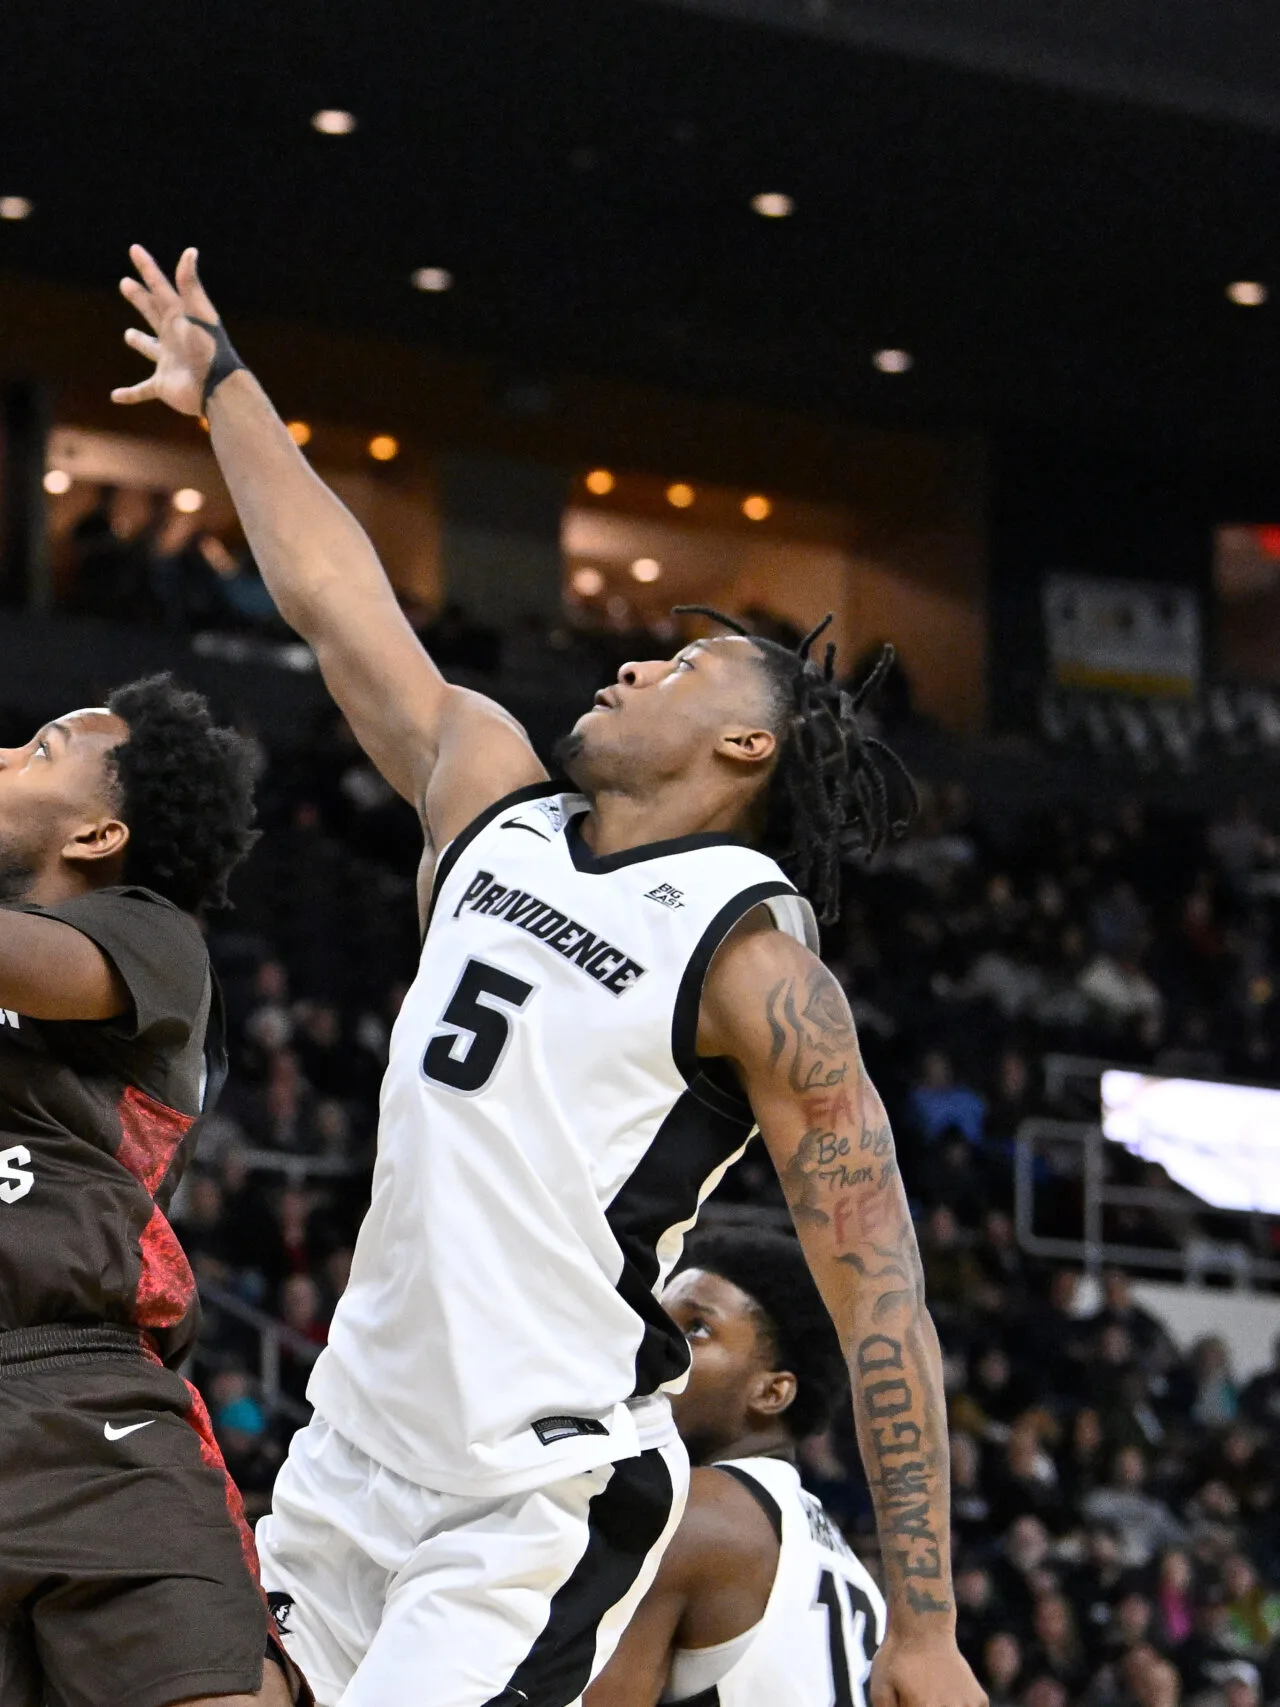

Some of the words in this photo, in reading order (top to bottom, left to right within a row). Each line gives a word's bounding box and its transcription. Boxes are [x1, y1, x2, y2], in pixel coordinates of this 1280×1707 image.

[648, 889, 685, 909] EAST
[658, 883, 684, 899] BIG
[453, 869, 648, 998] PROVIDENCE
[420, 955, 540, 1097] 5
